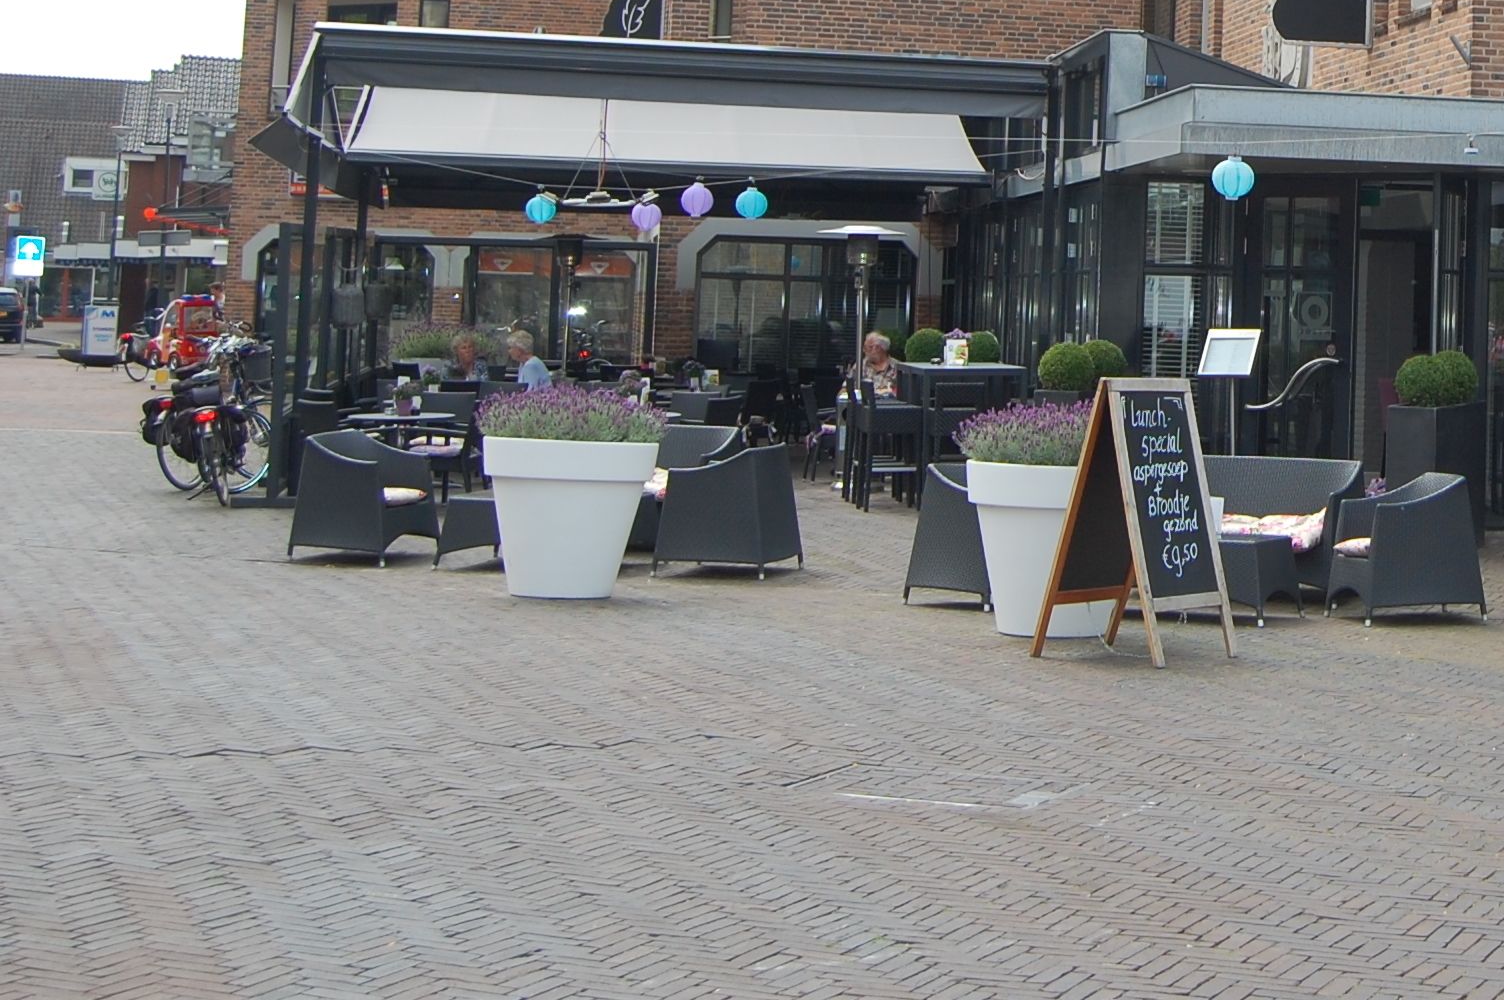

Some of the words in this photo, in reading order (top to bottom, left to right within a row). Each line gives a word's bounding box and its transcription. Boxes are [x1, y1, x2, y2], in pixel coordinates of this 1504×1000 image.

[1134, 460, 1188, 486] aspergesoep
[1148, 489, 1190, 521] Broodje
[1163, 509, 1199, 542] gezond
